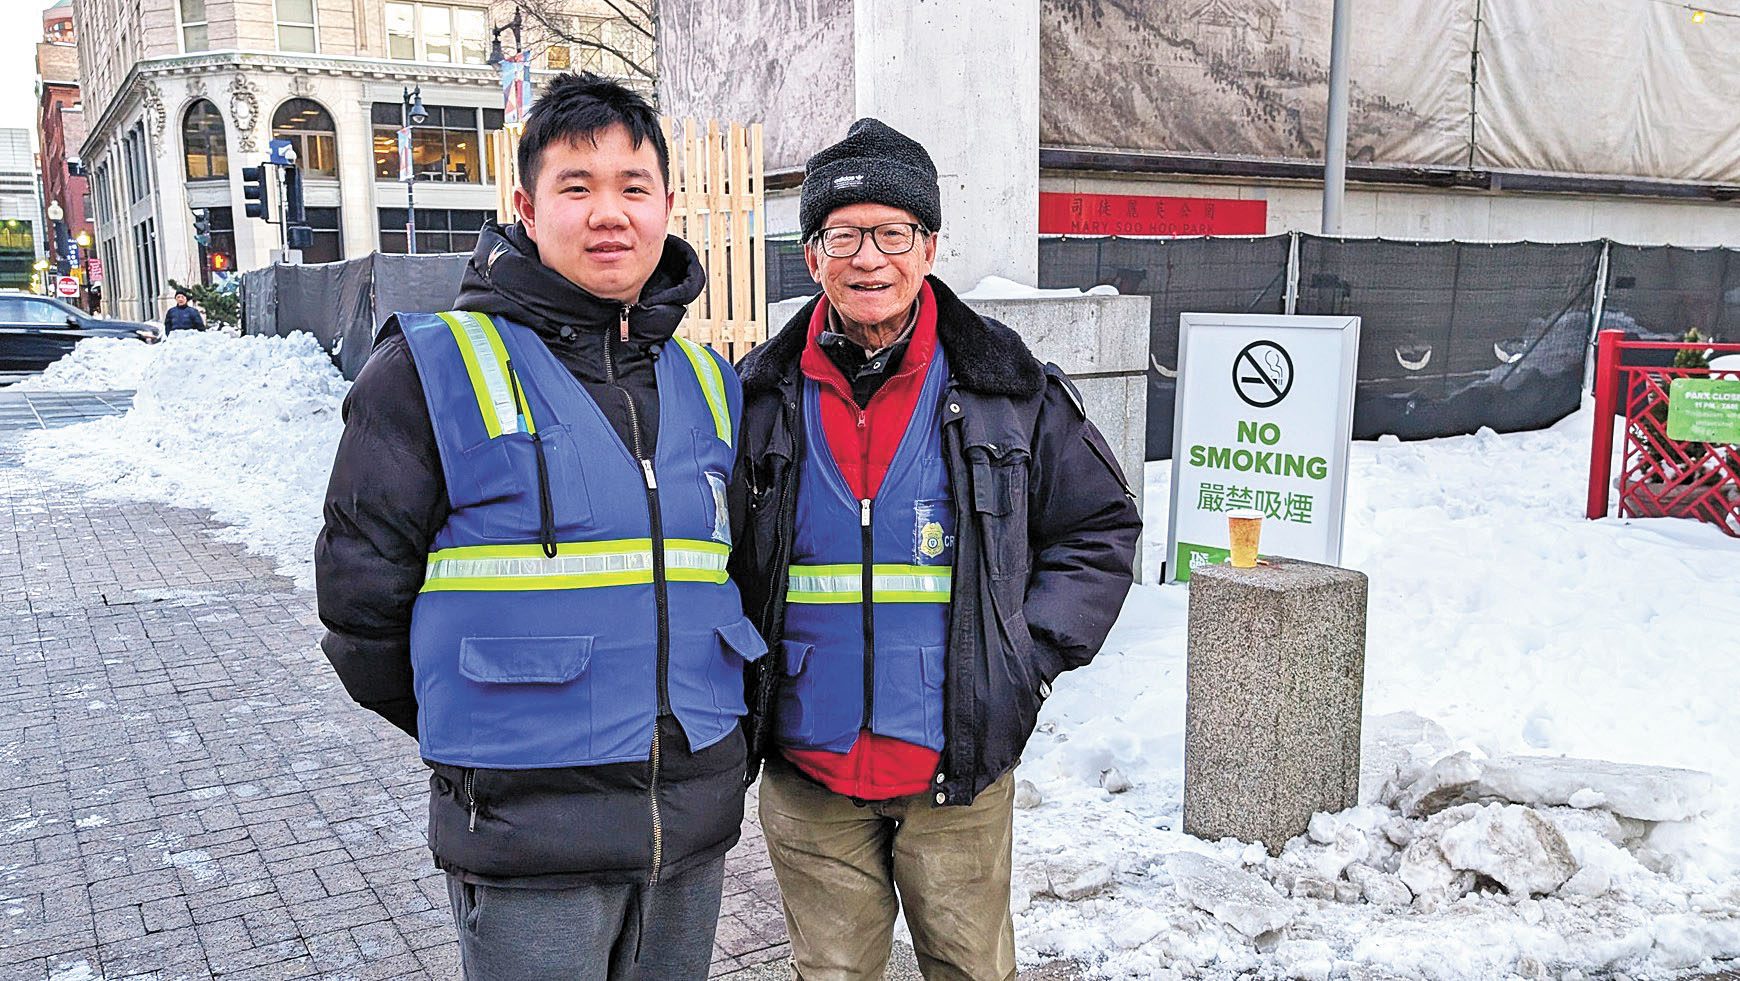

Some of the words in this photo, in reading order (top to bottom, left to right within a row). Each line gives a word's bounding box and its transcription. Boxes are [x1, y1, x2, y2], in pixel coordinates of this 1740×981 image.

[1071, 220, 1109, 233] MARY
[1115, 221, 1143, 233] SOO
[1149, 223, 1177, 234] HOO
[1183, 223, 1214, 234] PARK
[1237, 420, 1281, 446] NO
[1189, 445, 1328, 481] SMOKING
[1197, 482, 1314, 524] 嚴禁吸煙
